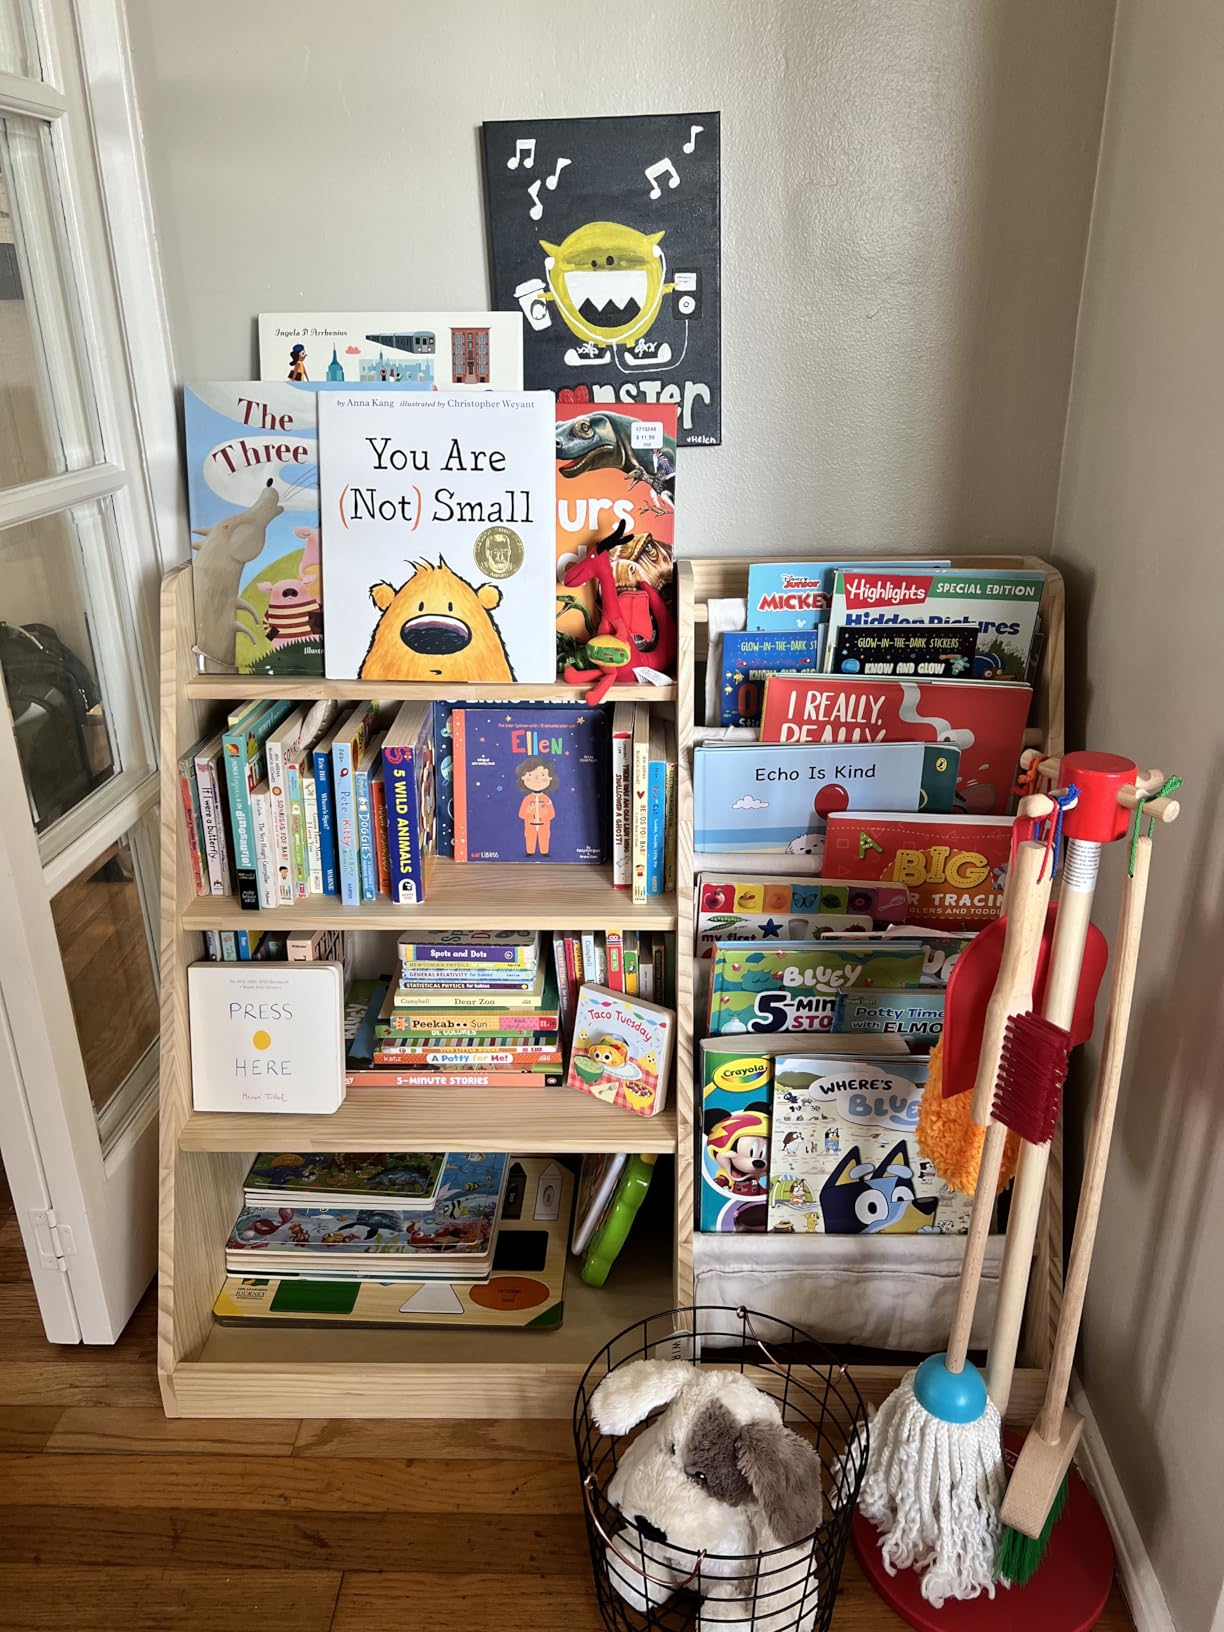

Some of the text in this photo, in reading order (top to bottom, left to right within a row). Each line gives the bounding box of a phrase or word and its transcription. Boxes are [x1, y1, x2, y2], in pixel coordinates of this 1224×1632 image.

[275, 328, 301, 337] Ingela
[237, 397, 294, 431] The
[336, 399, 534, 410] by Anna Kang illustrated by Christopher Weyant
[212, 441, 308, 474] Three
[365, 438, 506, 471] You Are
[338, 484, 534, 531] (Not) Small
[558, 498, 635, 533] urs
[846, 578, 926, 605] Highlights
[936, 582, 1035, 597] SPECIAL EDITION
[930, 638, 959, 648] STICKERS
[864, 662, 945, 675] KNOW AND GLOW
[788, 690, 797, 719] I
[803, 690, 886, 726] REALLY,
[317, 758, 328, 781] Eric Hill
[622, 764, 630, 783] THERE
[755, 764, 876, 781] Echo Is Kind
[615, 773, 623, 811] SWALLOWED
[204, 800, 212, 818] were
[320, 792, 330, 830] Where's Spot?
[623, 797, 630, 809] AN
[393, 769, 412, 874] 5 WILD ANIMALS
[258, 832, 266, 843] Very
[280, 832, 288, 844] FOR
[339, 818, 352, 847] Kitty
[359, 813, 370, 859] DOGGIES
[858, 831, 883, 859] A
[893, 845, 990, 889] BIG
[326, 869, 334, 891] WARNE
[430, 949, 487, 958] Spots and Dots
[783, 964, 862, 990] BLUEY
[229, 1002, 293, 1021] PRESS
[751, 991, 836, 1033] 5-MIN
[855, 1007, 903, 1020] Potty
[471, 1016, 488, 1027] Sun
[587, 1008, 652, 1043] Taco Tuesday
[792, 1015, 833, 1031] STO
[851, 1021, 880, 1029] with
[235, 1058, 292, 1078] HERE
[441, 1055, 470, 1063] Potty
[396, 1076, 489, 1085] 5-MINUTE STORIES
[723, 1064, 765, 1080] Crayola
[818, 1079, 893, 1095] WHERE'S
[848, 1093, 920, 1117] BLUE
